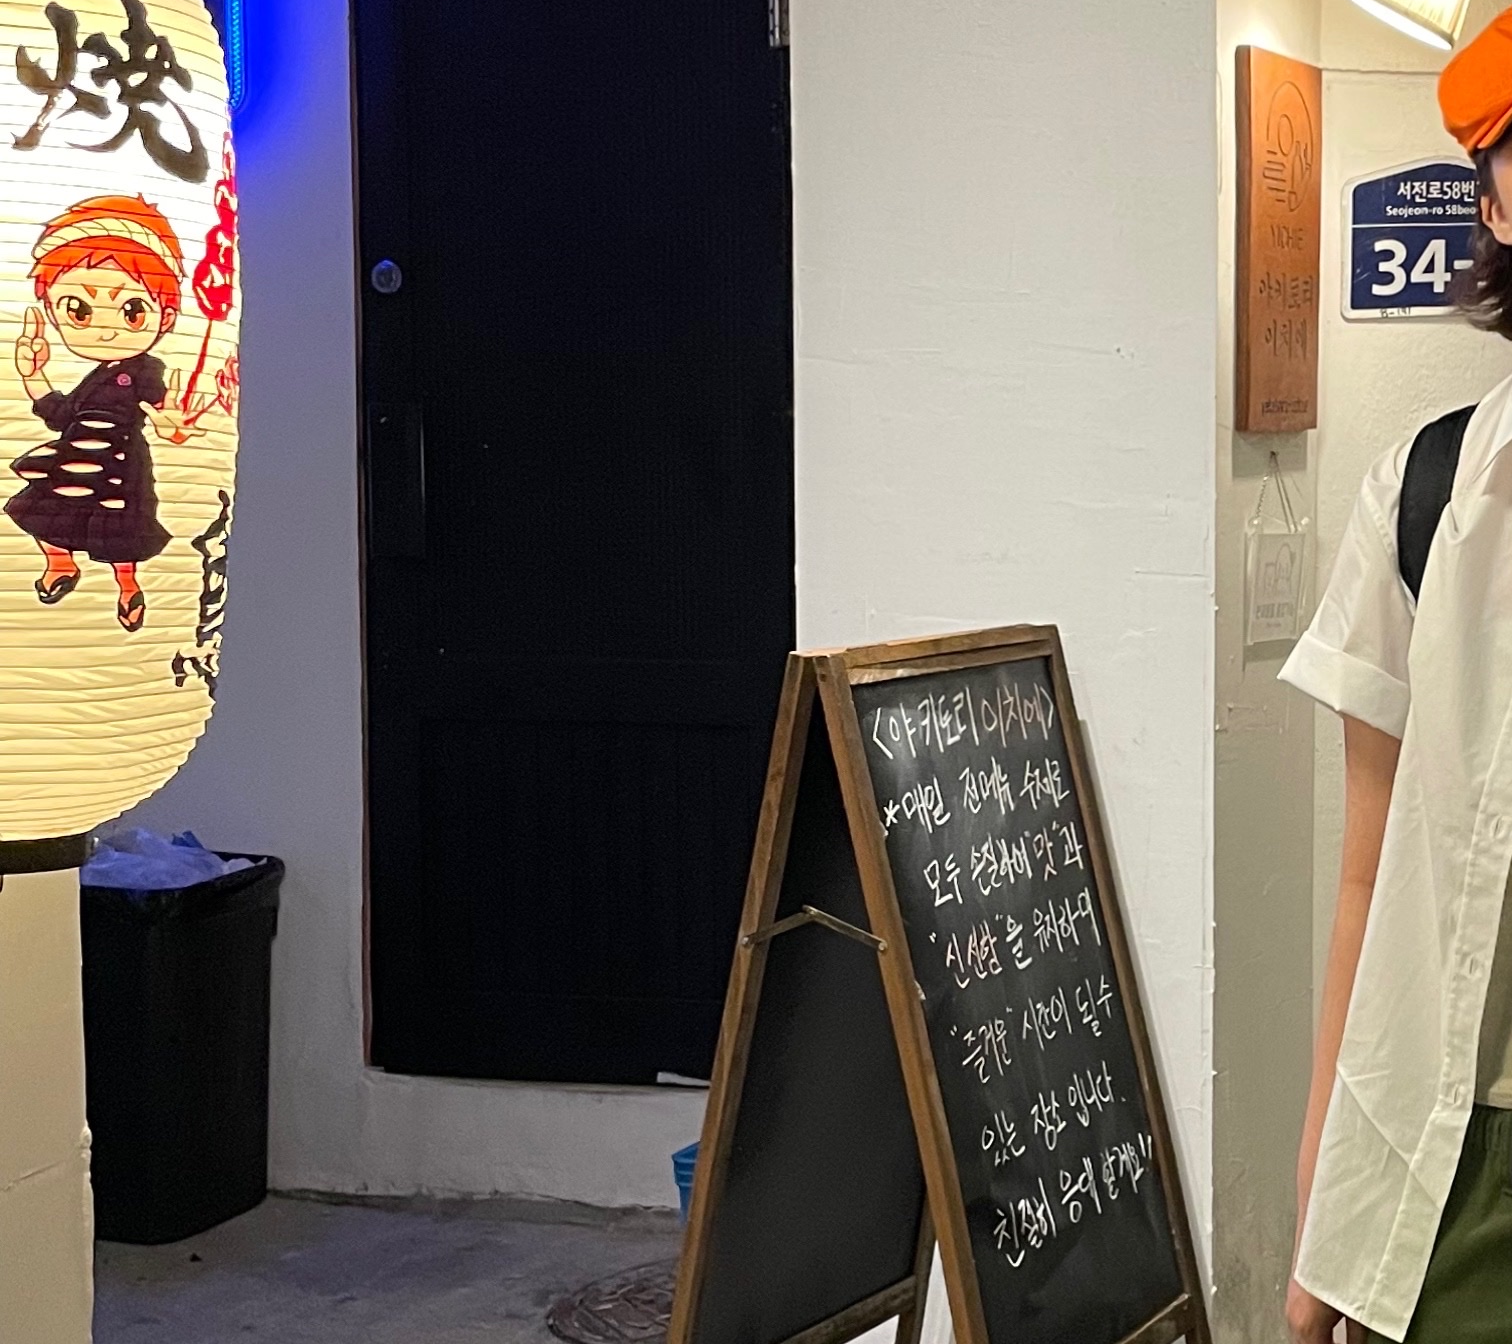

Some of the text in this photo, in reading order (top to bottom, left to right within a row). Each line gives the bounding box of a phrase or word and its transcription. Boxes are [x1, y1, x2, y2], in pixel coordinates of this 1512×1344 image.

[1386, 205, 1478, 218] Seojeon-ro 58beo
[1397, 181, 1480, 202] 서전로58번
[1371, 239, 1474, 296] 34-
[1264, 318, 1309, 360] 이치에
[923, 853, 964, 907] 모두
[1022, 986, 1073, 1051] 시간이
[981, 1110, 1026, 1167] 있는
[1030, 1090, 1067, 1150] 장소
[993, 1177, 1057, 1267] 친절히
[1059, 1157, 1102, 1223] 응대
